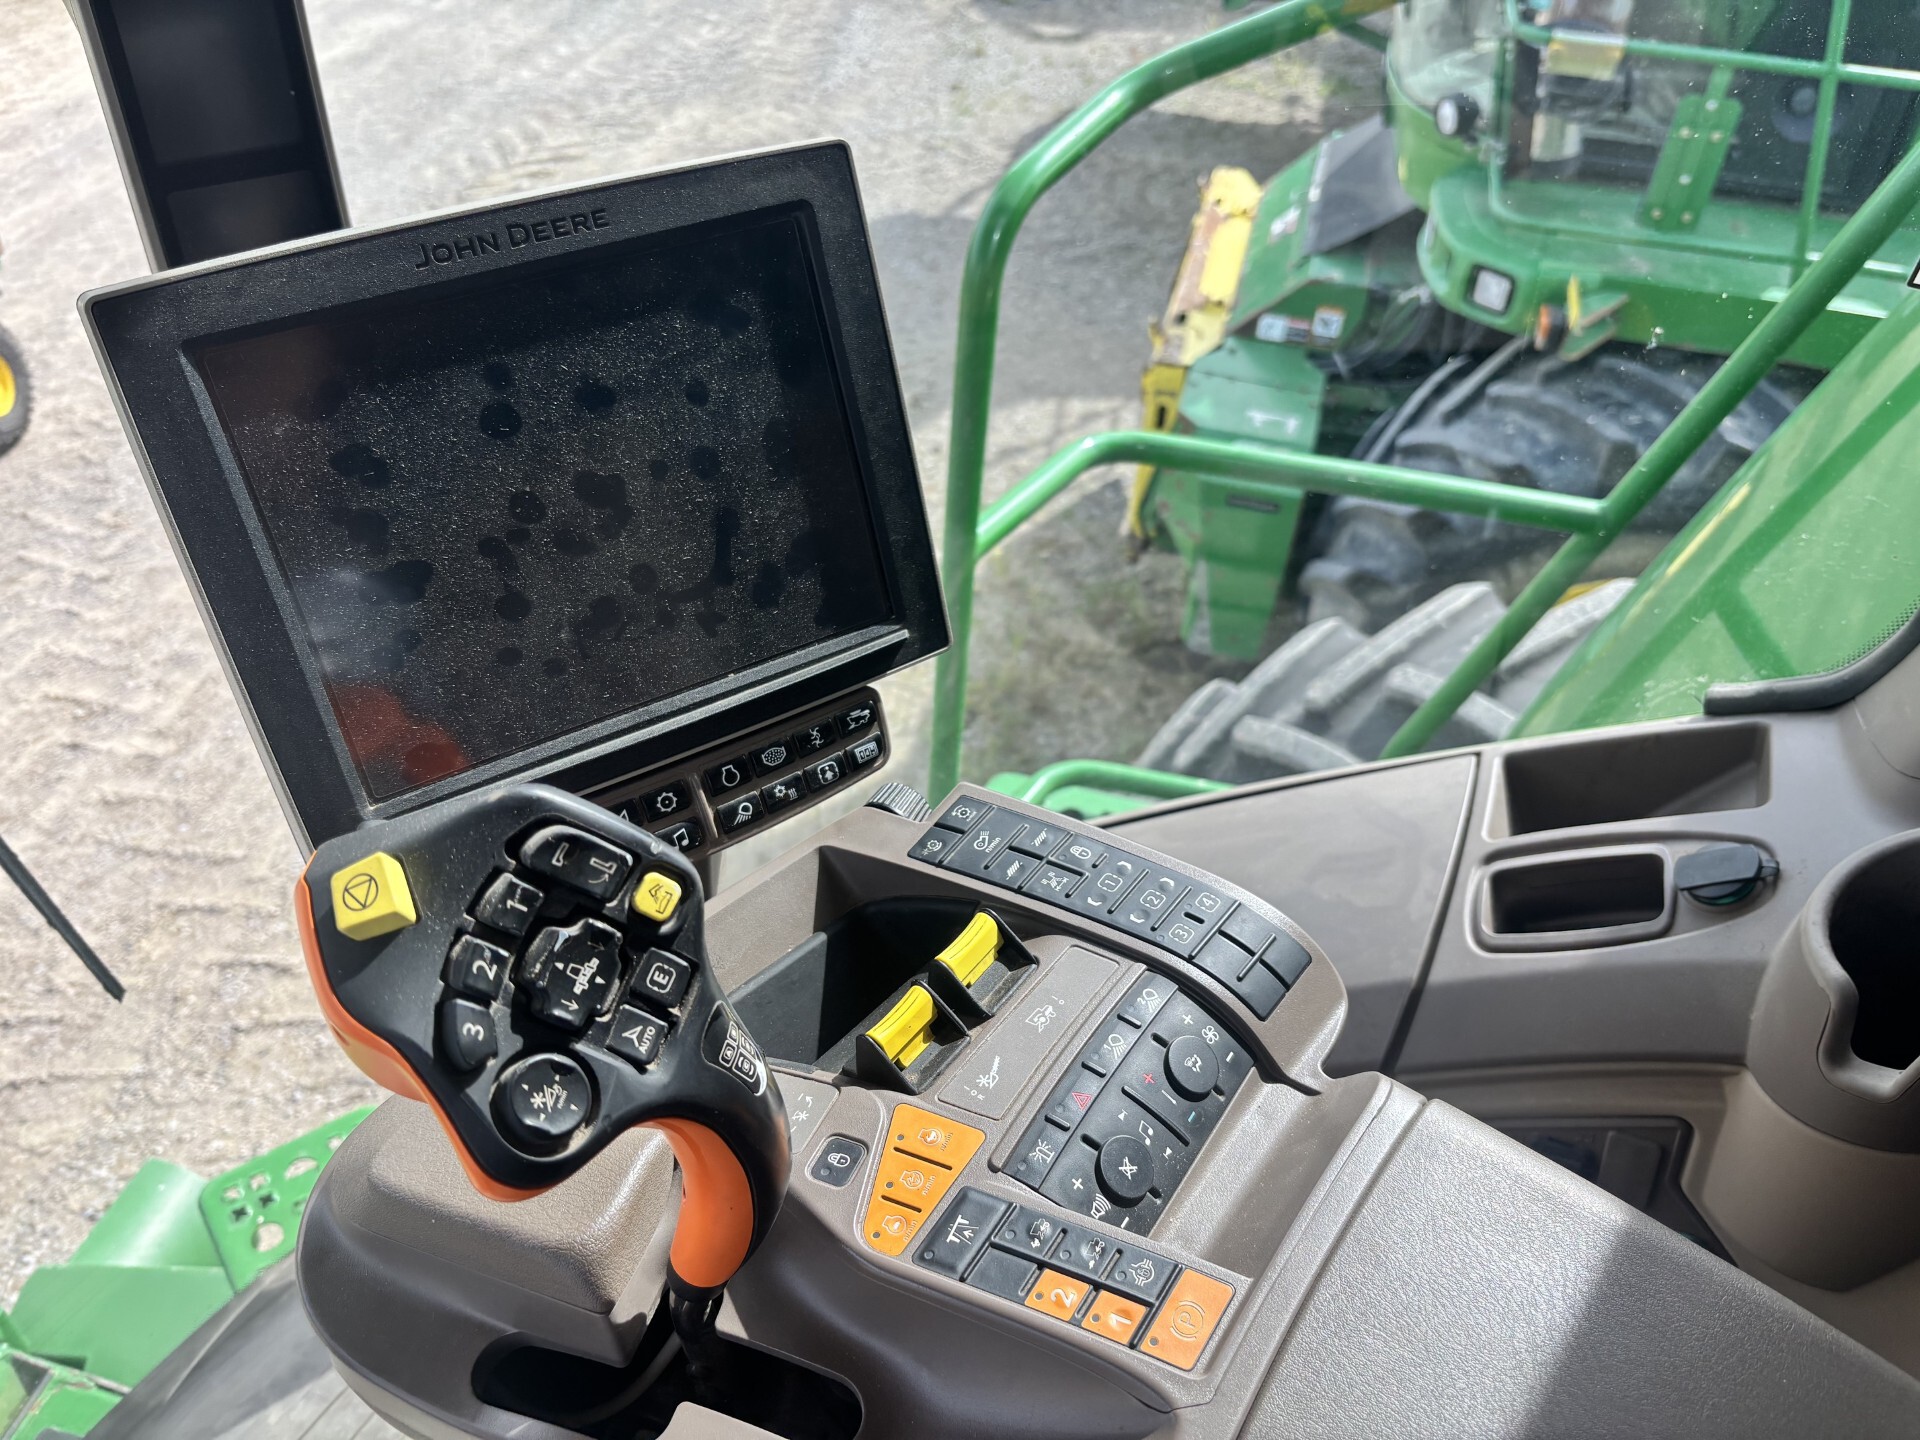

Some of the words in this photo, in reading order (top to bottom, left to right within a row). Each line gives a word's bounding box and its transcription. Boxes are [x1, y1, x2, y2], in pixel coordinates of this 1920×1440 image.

[414, 232, 501, 271] JOHN
[506, 208, 610, 250] DEERE
[985, 837, 1002, 853] n/min
[506, 899, 528, 913] 1
[1146, 895, 1160, 905] 2
[1203, 897, 1215, 907] 4
[1174, 929, 1189, 939] 3
[472, 959, 498, 981] 2
[652, 970, 670, 985] E
[1136, 996, 1146, 1006] 2
[462, 1022, 485, 1042] 3
[638, 1025, 656, 1054] AUTO
[1103, 1042, 1111, 1051] 1
[1051, 1288, 1077, 1308] 2
[1108, 1311, 1132, 1328] 1
[1178, 1311, 1196, 1329] P
